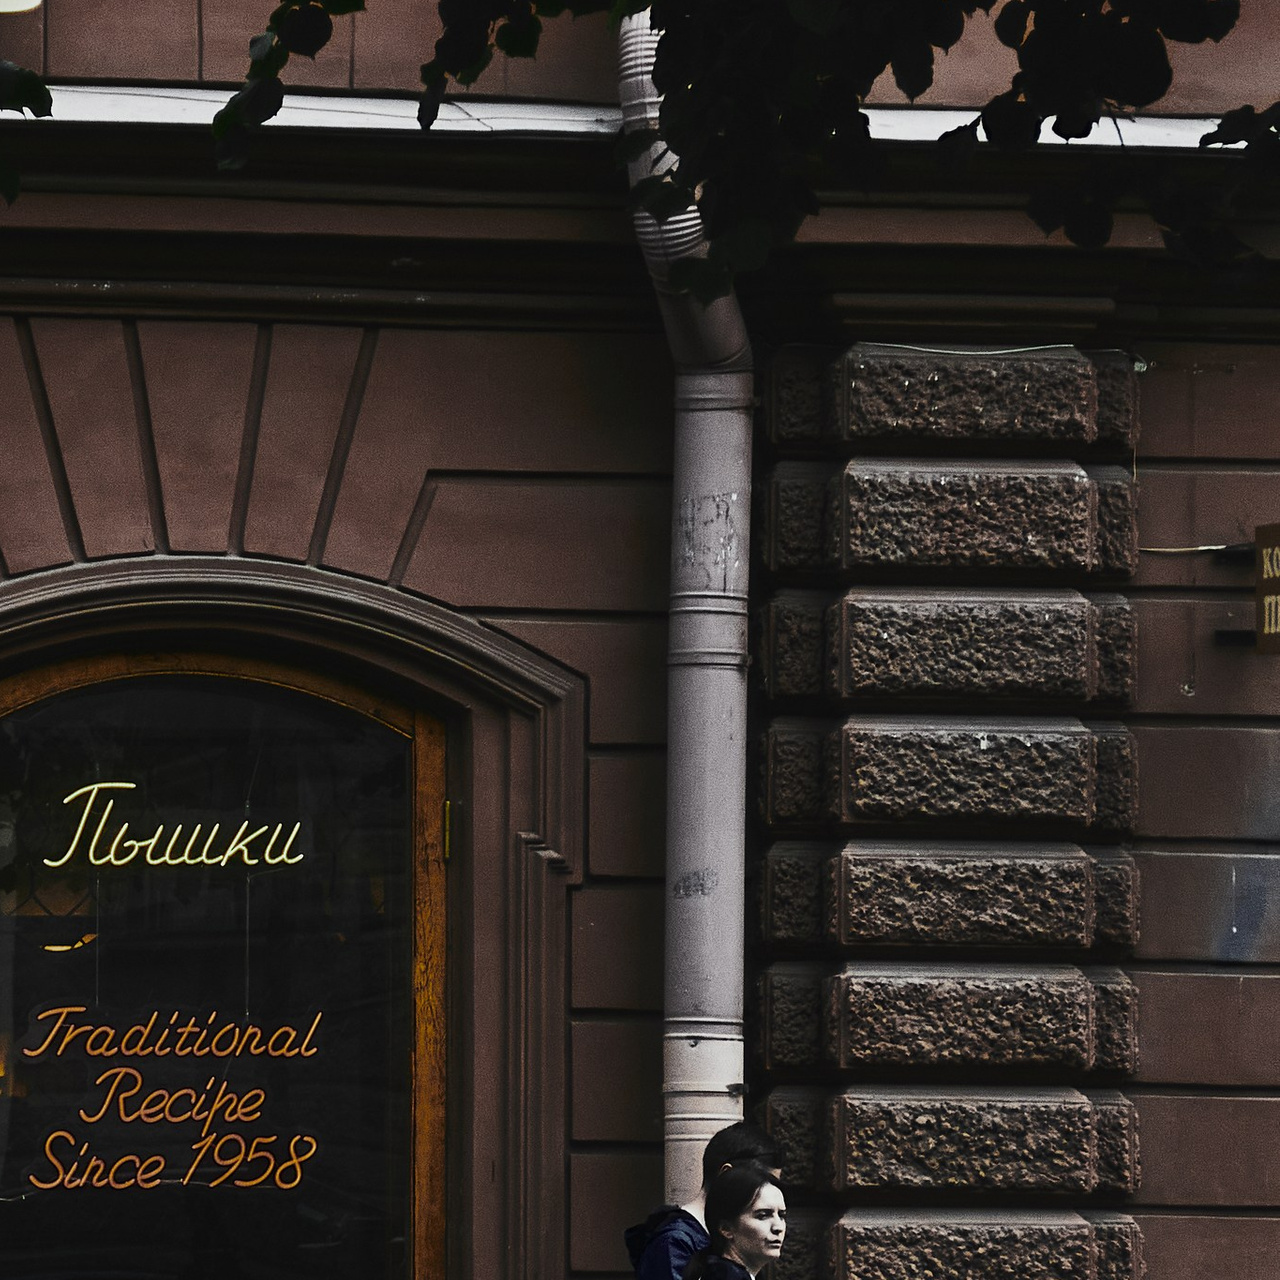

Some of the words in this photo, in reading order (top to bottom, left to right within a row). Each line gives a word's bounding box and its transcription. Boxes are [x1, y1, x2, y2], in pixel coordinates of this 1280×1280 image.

[43, 781, 304, 867] Пышки
[21, 1005, 324, 1058] Traditional
[79, 1066, 266, 1139] Recipe
[27, 1129, 166, 1190] Since
[179, 1131, 318, 1190] 1958
